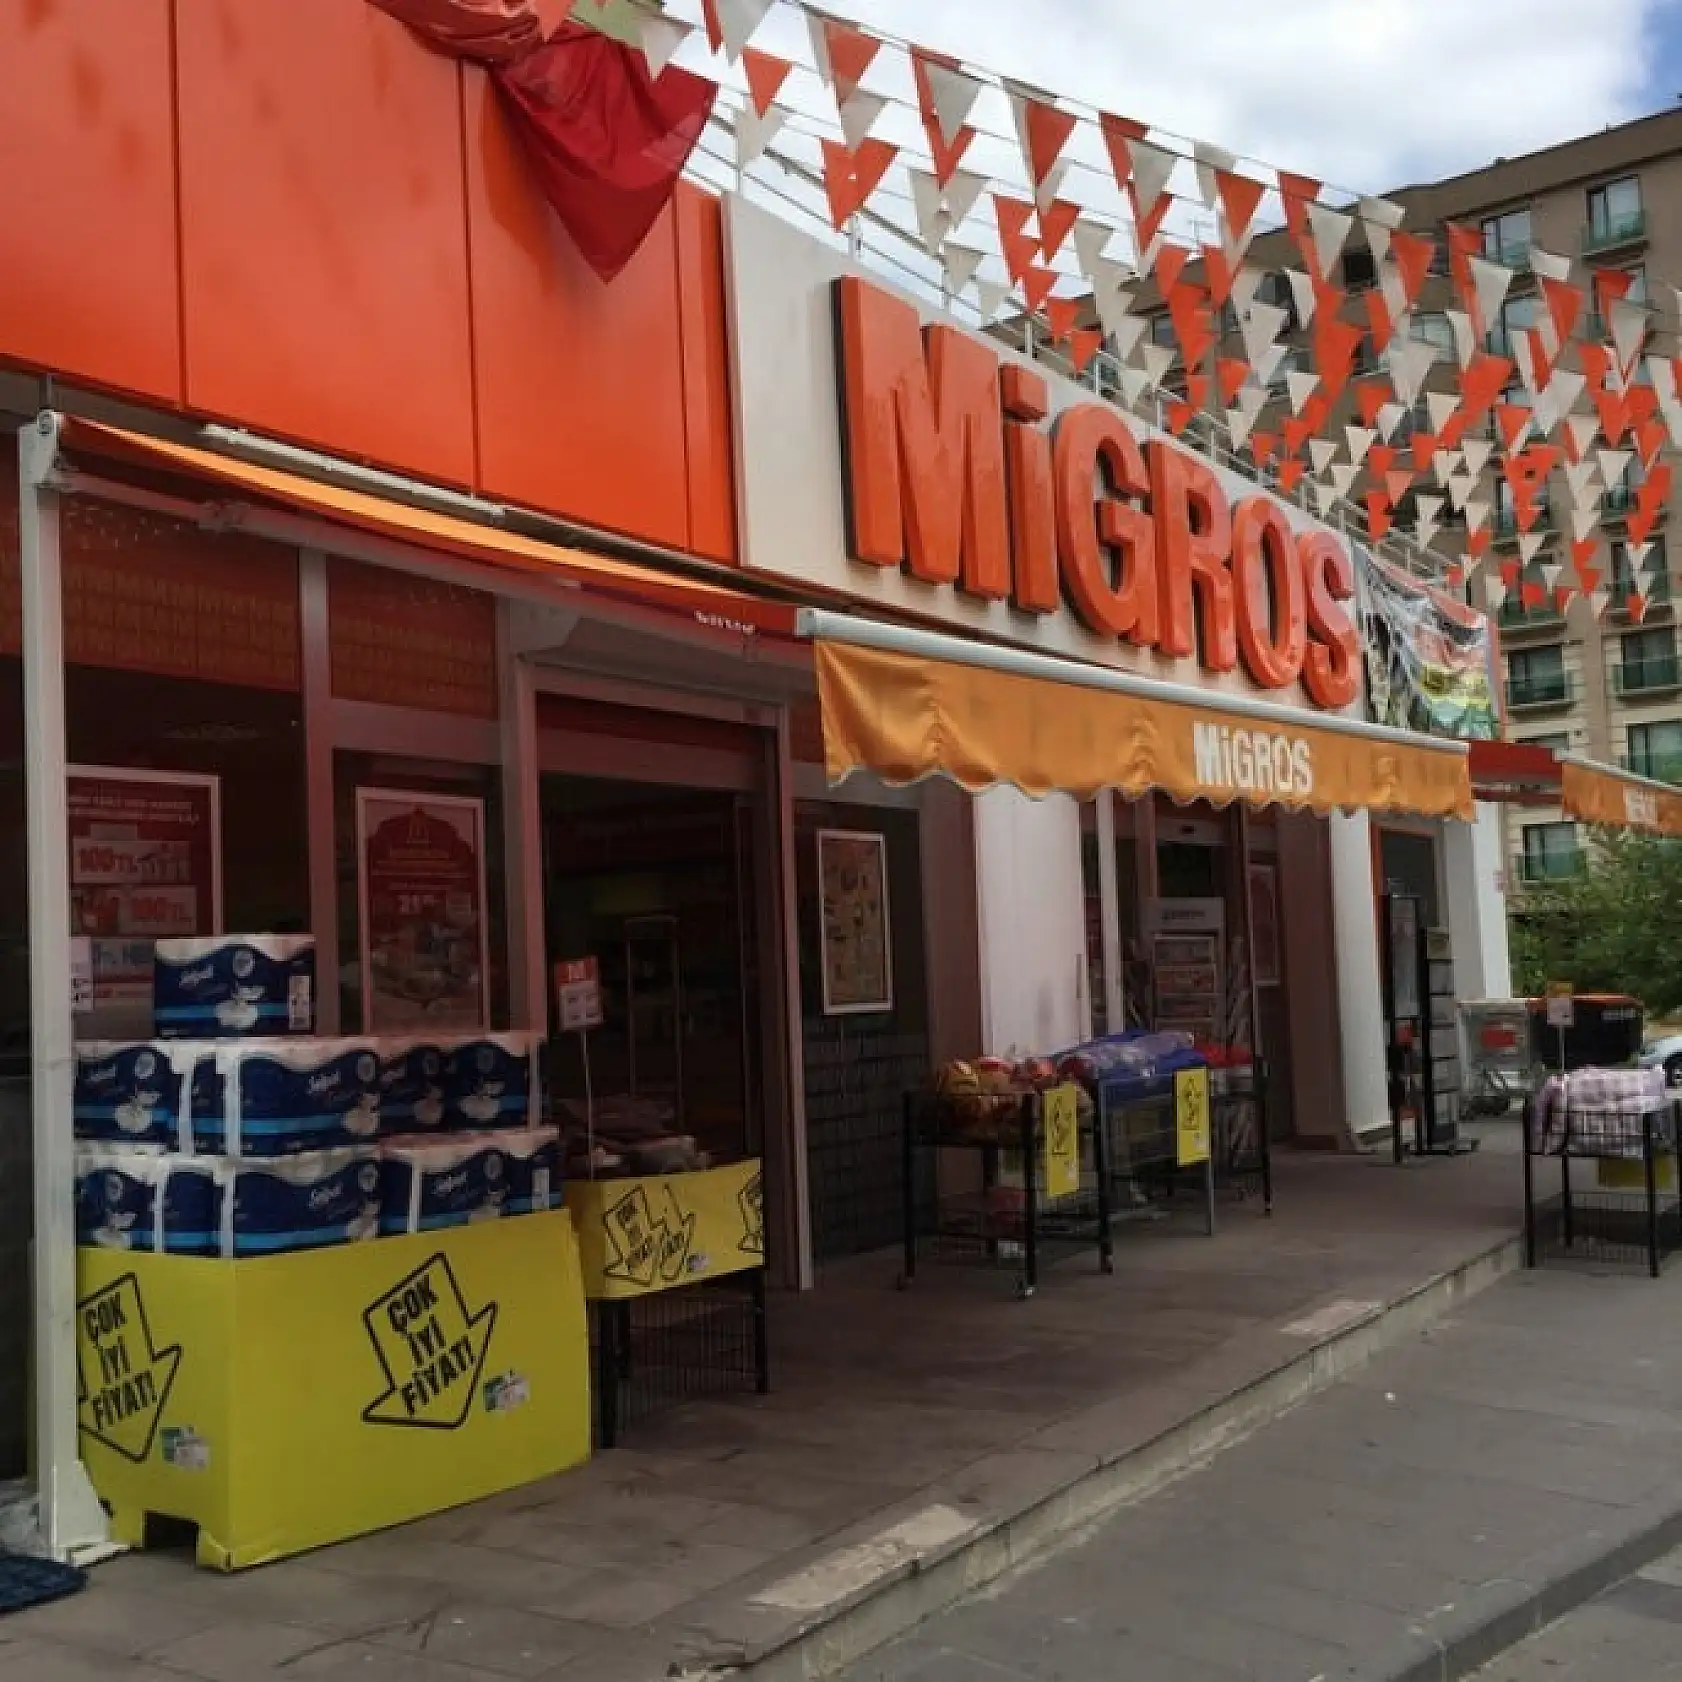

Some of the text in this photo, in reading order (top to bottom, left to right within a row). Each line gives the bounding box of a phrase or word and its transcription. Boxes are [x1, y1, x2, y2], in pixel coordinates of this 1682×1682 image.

[833, 274, 1359, 709] MiGROS
[1193, 721, 1313, 794] MiGROS
[86, 1292, 127, 1346] ÇOK
[387, 1275, 439, 1334] ÇOK
[98, 1336, 131, 1384] İYİ
[407, 1314, 446, 1367] İYİ
[402, 1335, 475, 1416] FİYAT!
